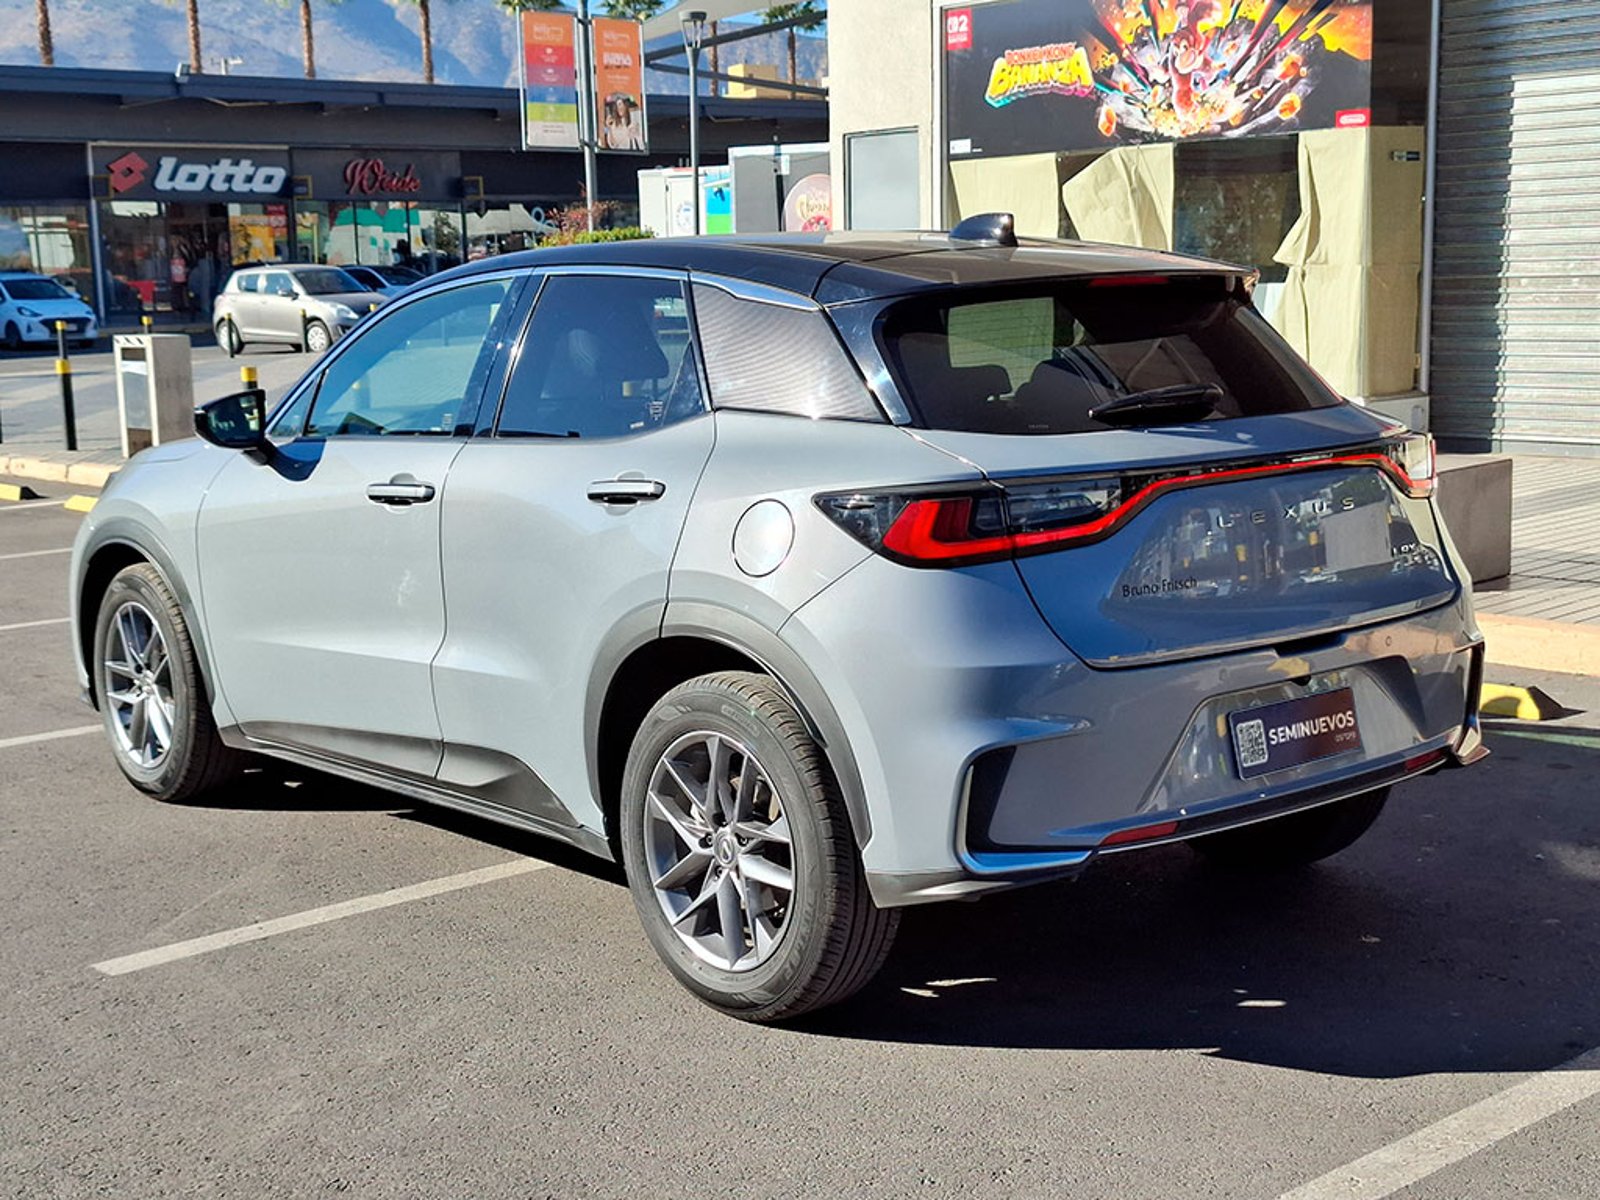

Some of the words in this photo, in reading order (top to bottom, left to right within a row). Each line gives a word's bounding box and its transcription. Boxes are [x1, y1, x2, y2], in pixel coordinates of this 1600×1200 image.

[988, 47, 1093, 100] BANANZA
[154, 156, 286, 193] lotto
[1217, 497, 1355, 528] LEXUS
[1122, 583, 1159, 598] Bruno
[1162, 576, 1198, 593] Fritsch
[1268, 710, 1355, 745] SEMINUEVOS
